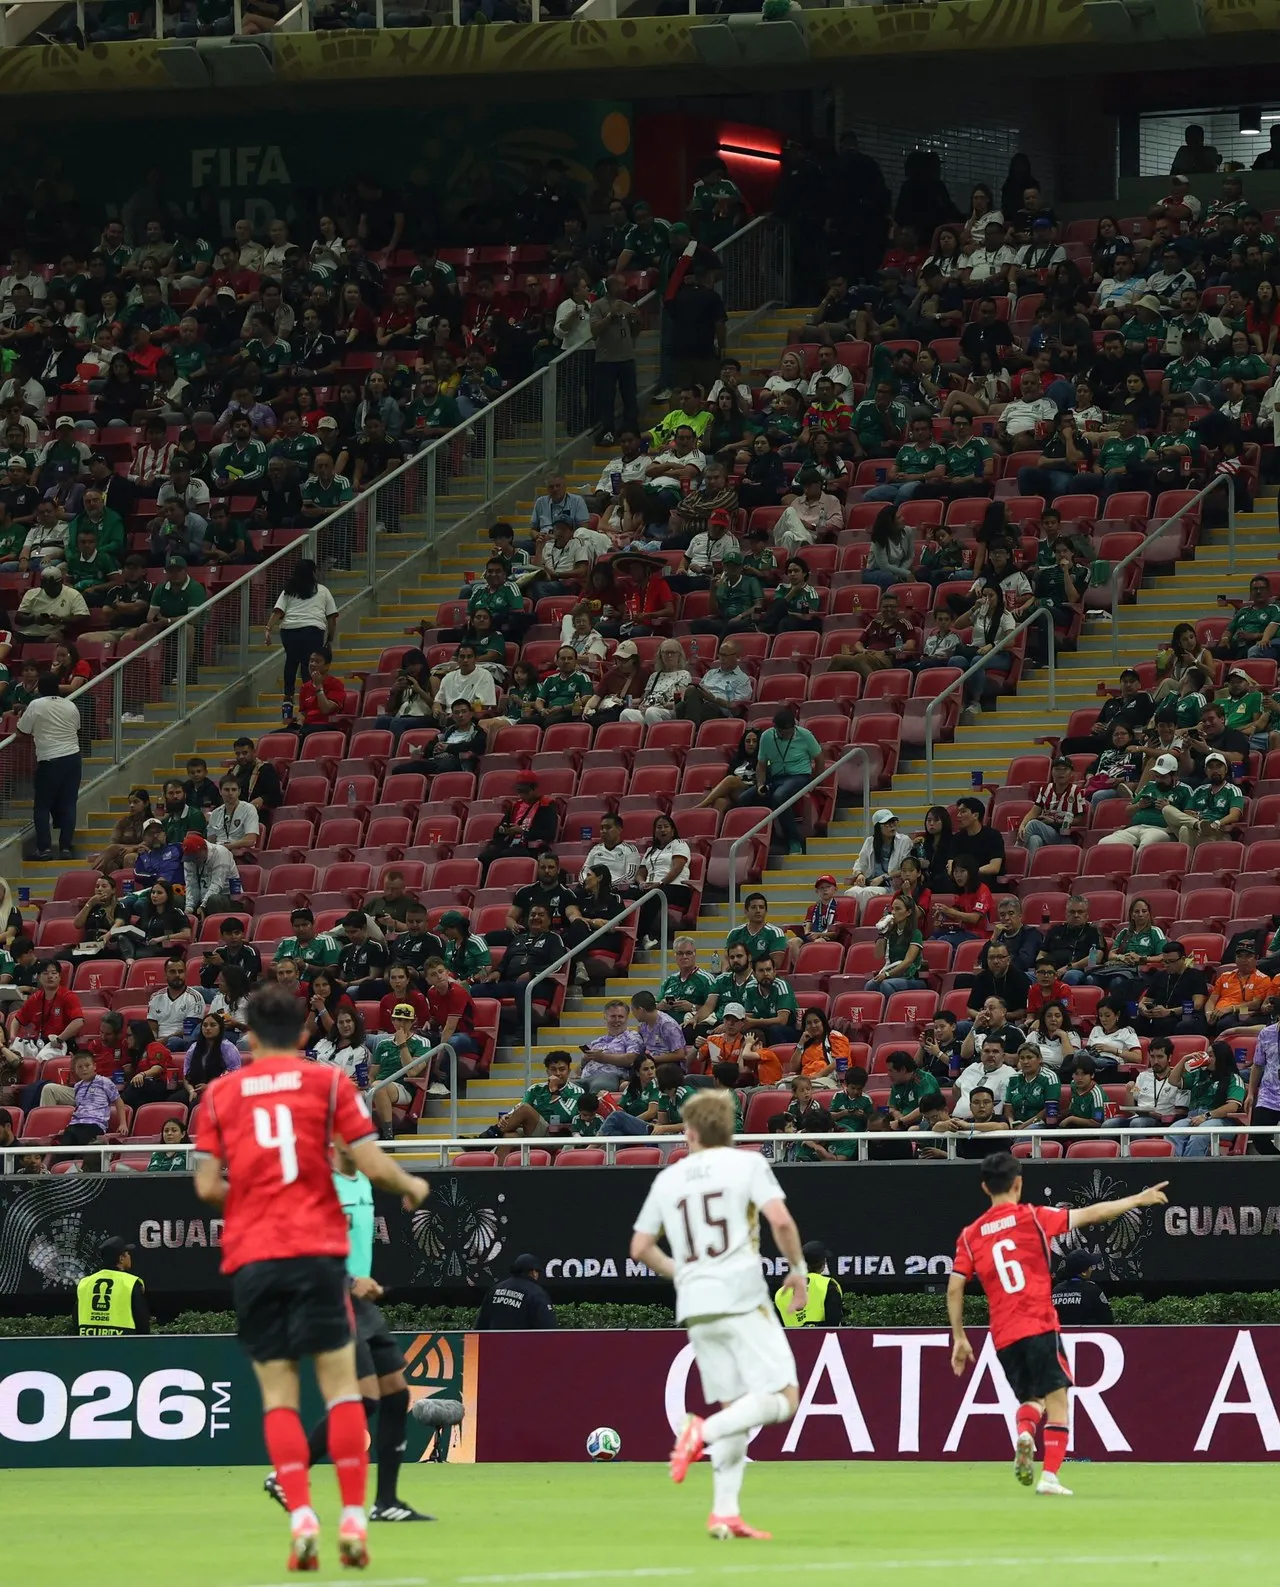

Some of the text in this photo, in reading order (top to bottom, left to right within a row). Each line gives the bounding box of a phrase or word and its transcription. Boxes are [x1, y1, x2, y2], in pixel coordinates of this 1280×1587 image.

[190, 145, 291, 188] FIFA
[253, 1103, 299, 1185] 4
[676, 1191, 729, 1262] 15
[545, 1258, 618, 1278] COPA
[837, 1255, 896, 1276] FIFA
[904, 1255, 954, 1276] 20
[992, 1238, 1026, 1294] 6
[492, 1297, 522, 1309] ZAPOPAN
[1052, 1297, 1082, 1305] APOPAN
[79, 1327, 124, 1336] ECURITY
[0, 1368, 232, 1443] 026 TM
